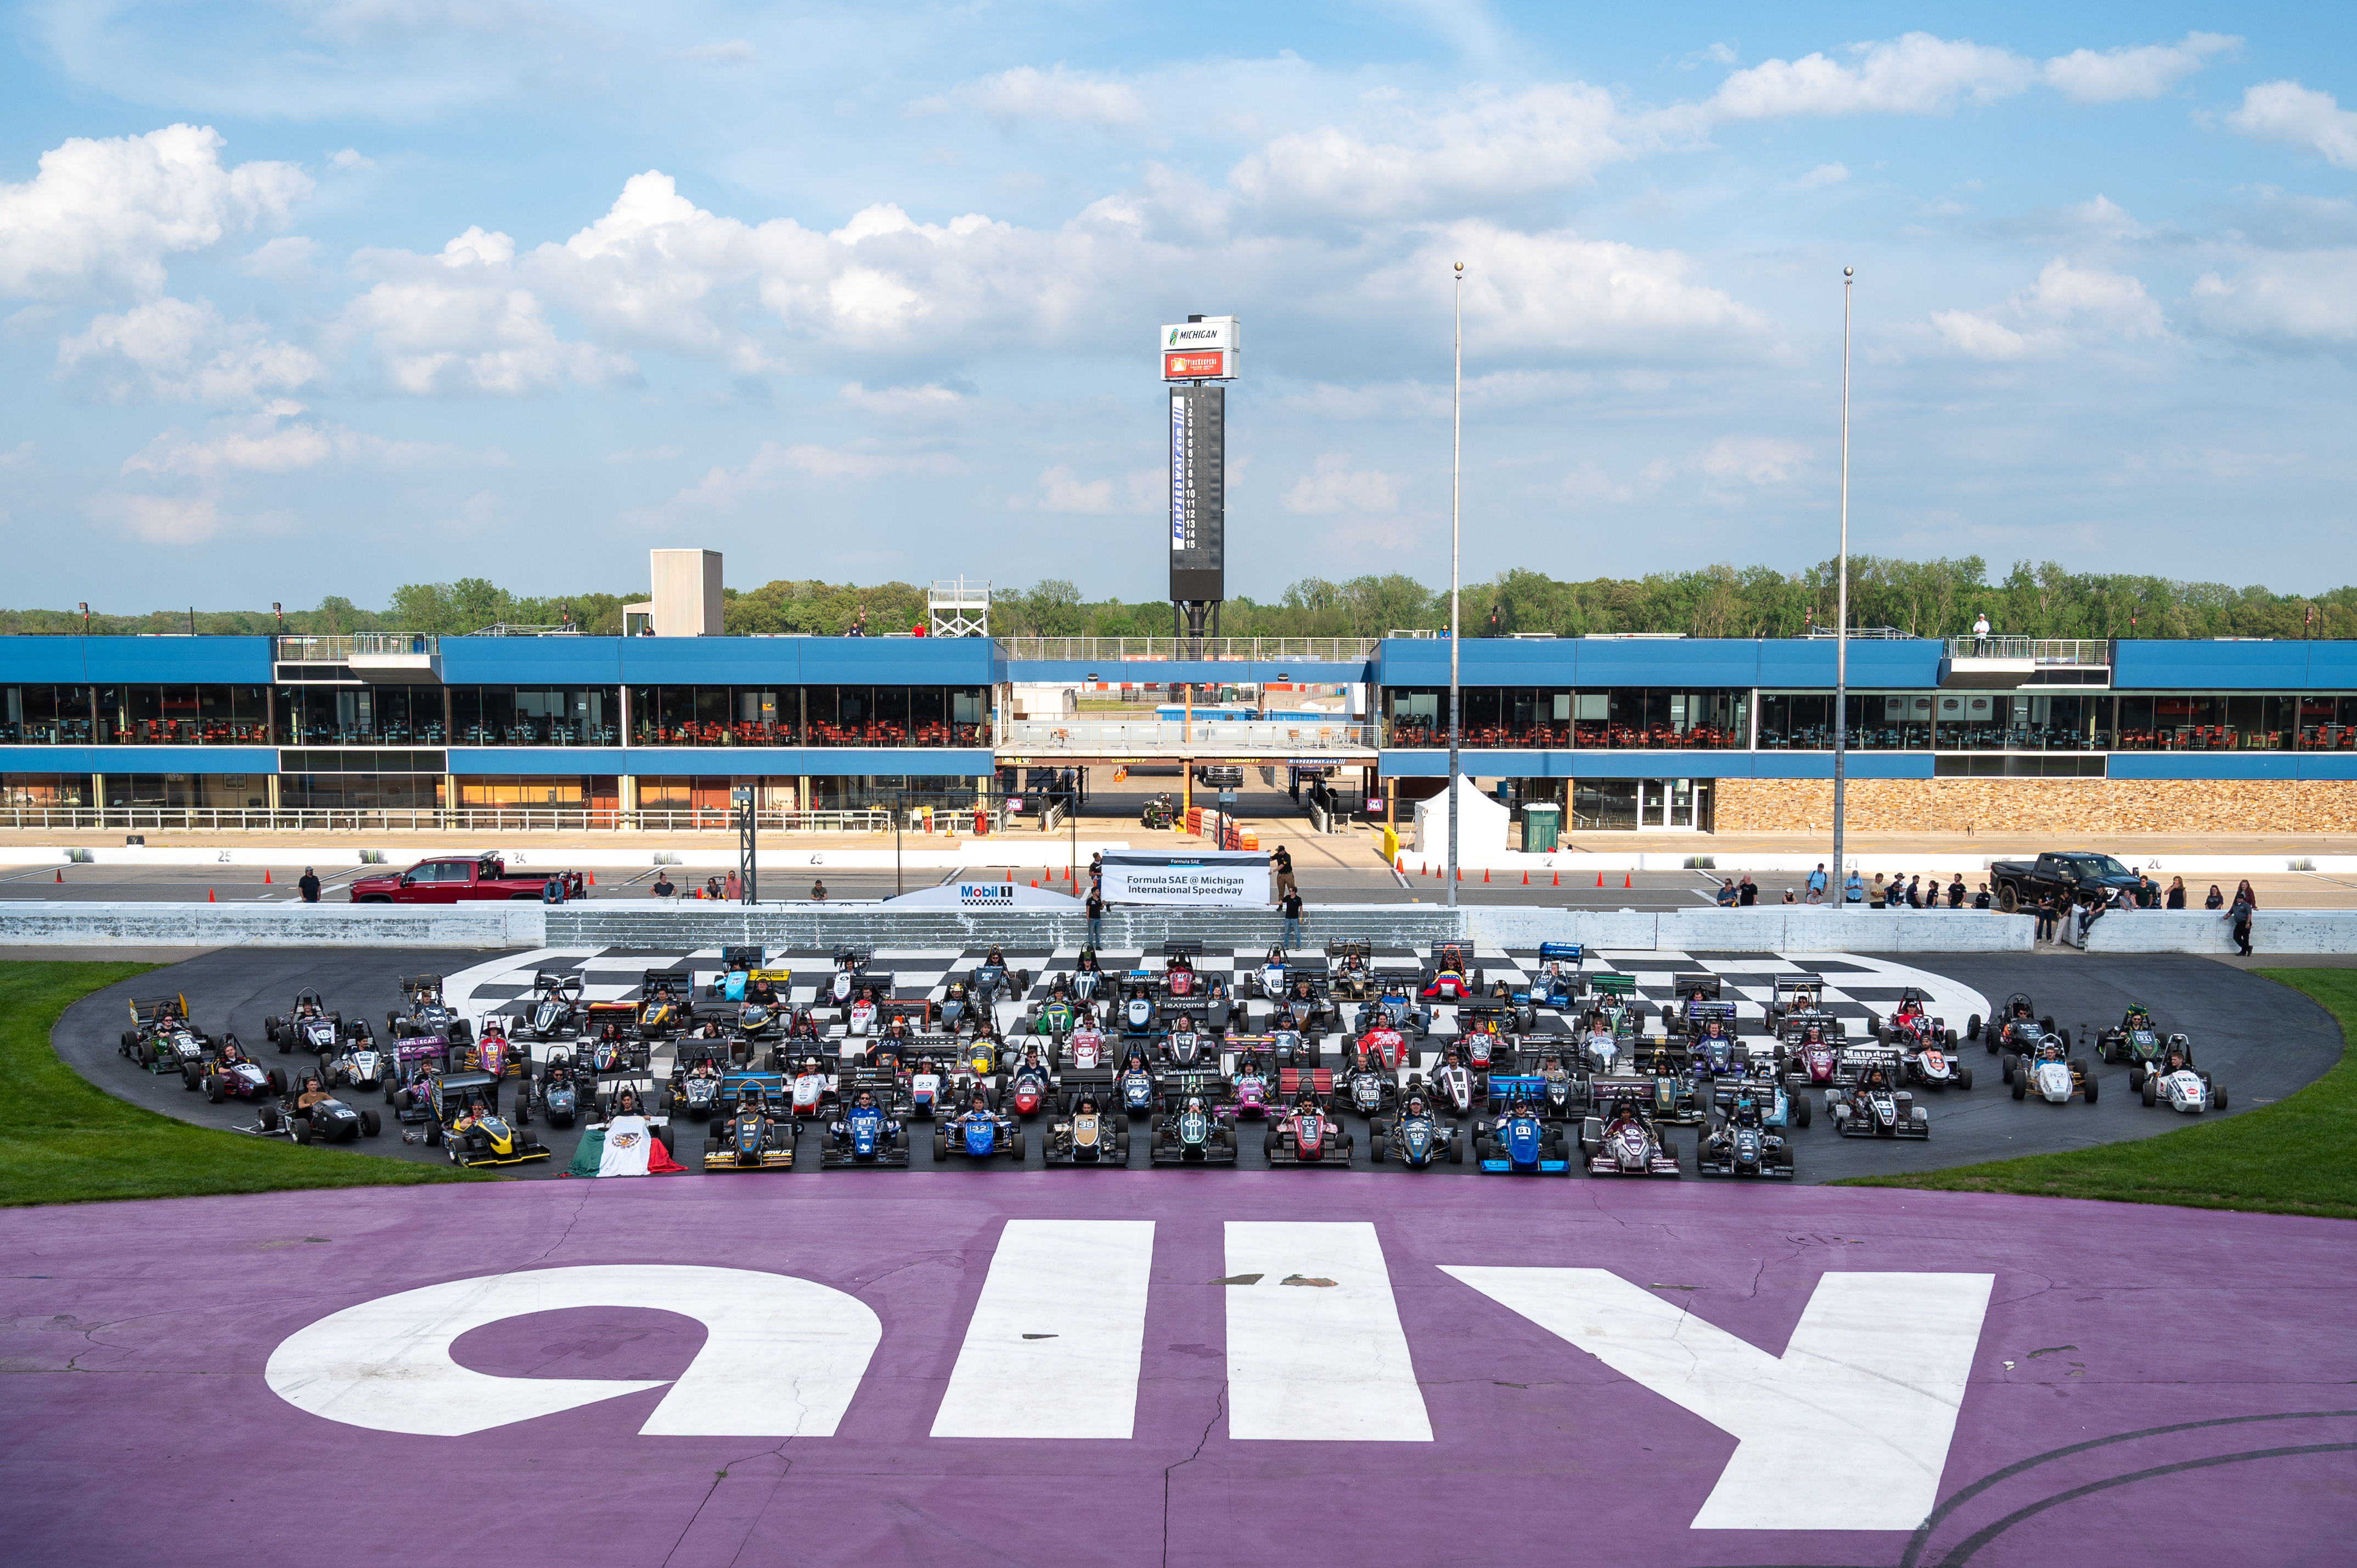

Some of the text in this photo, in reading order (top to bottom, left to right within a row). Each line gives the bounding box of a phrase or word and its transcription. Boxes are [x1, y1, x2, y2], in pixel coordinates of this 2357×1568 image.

[1179, 330, 1217, 339] MICHIGAN
[1188, 398, 1193, 407] 1
[1188, 408, 1193, 417] 2
[1188, 418, 1193, 427] 3
[1188, 428, 1193, 437] 4
[1188, 438, 1193, 448] 5
[1188, 449, 1193, 458] 6
[1188, 459, 1193, 467] 7
[1188, 469, 1193, 478] 8
[1188, 479, 1193, 488] 9
[1186, 489, 1195, 498] 10
[1186, 499, 1195, 508] 11
[1186, 509, 1195, 518] 12
[1186, 520, 1195, 528] 13
[1186, 529, 1195, 538] 14
[1186, 540, 1195, 549] 15
[218, 850, 231, 862] 25
[811, 853, 823, 865] 23
[1846, 858, 1858, 868] 21
[1190, 876, 1199, 885] @
[1201, 876, 1244, 887] Michigan
[961, 886, 1010, 897] Mobil 1
[1192, 886, 1243, 896] Speedway
[1843, 1050, 1894, 1058] Matador
[265, 1220, 1995, 1530] ally
